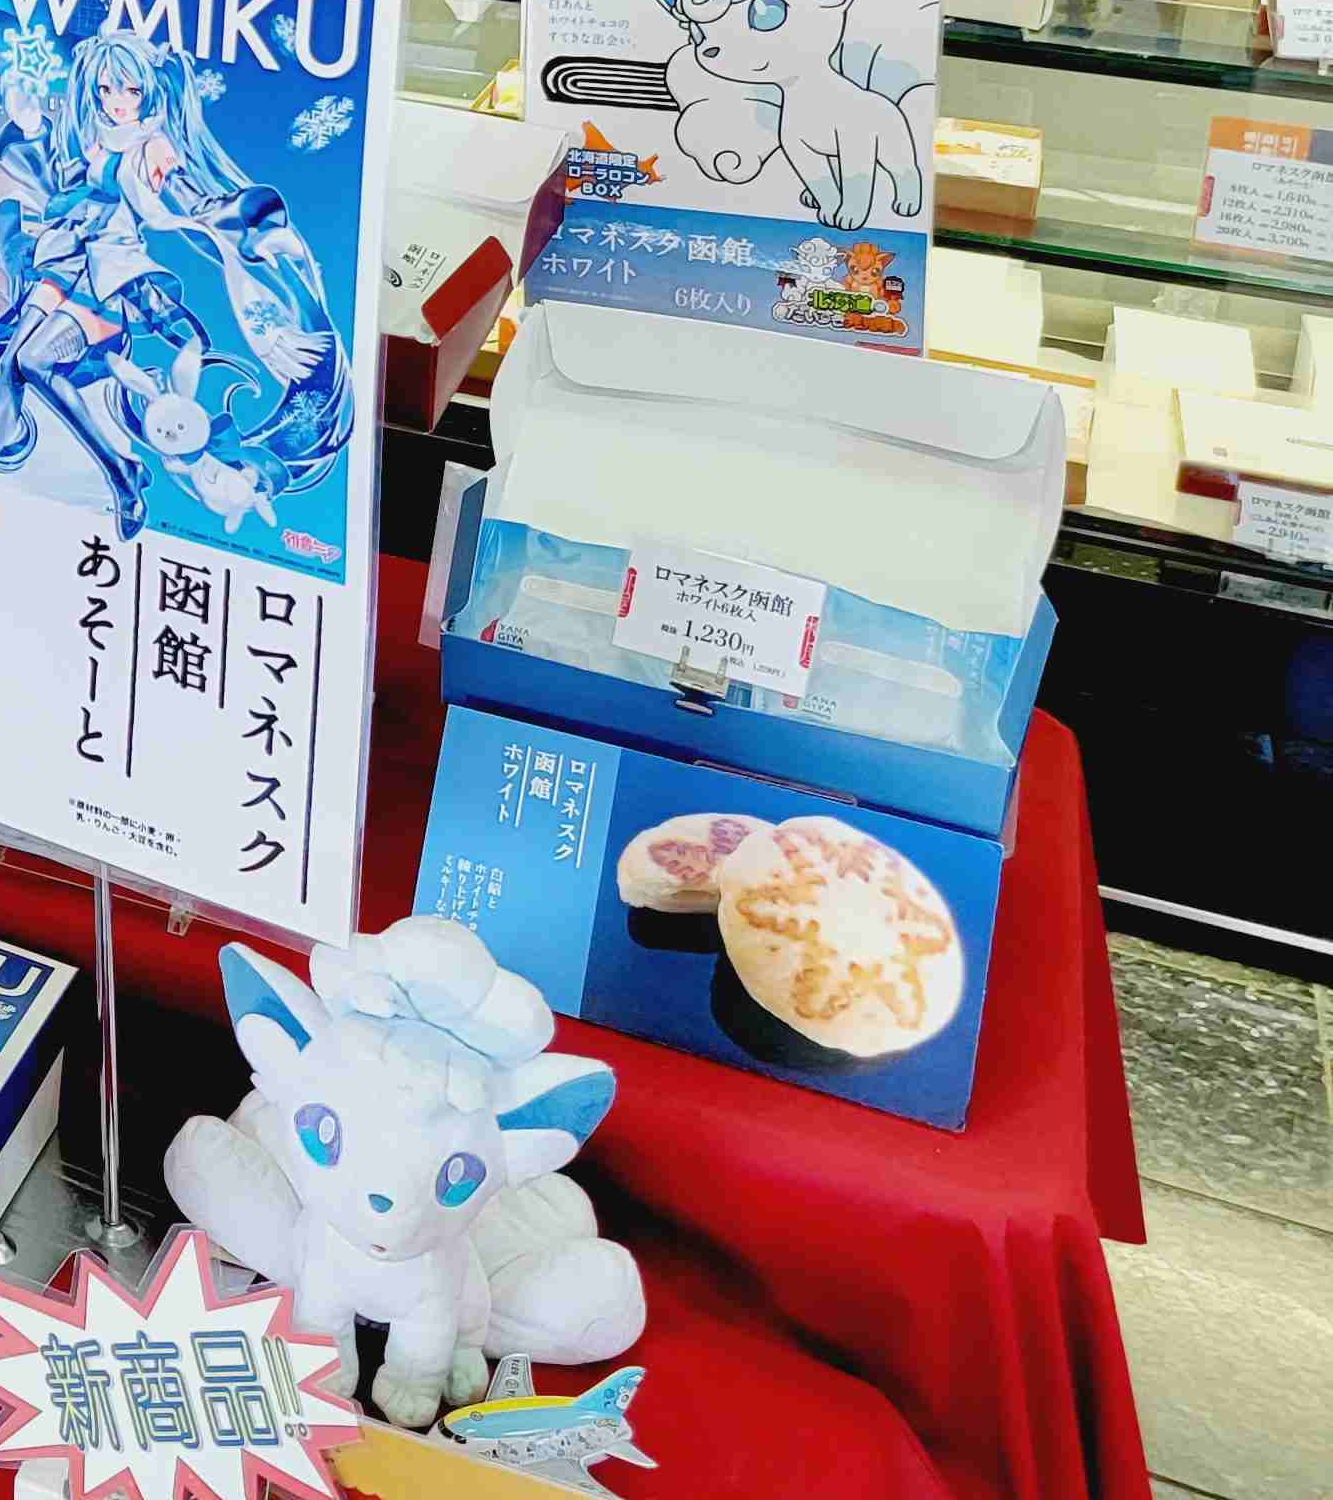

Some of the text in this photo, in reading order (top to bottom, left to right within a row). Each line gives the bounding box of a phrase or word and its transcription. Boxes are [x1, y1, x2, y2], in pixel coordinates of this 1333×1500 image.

[582, 183, 622, 198] BOX
[543, 252, 637, 285] ホワイト
[674, 286, 752, 316] 6枚入り
[654, 565, 794, 618] ロマネスク函館
[676, 591, 757, 623] ホワイト6枚入
[74, 534, 123, 764] あそーと
[153, 556, 212, 694] 函館
[683, 619, 755, 657] 1,230円
[238, 584, 299, 874] ロマネスク
[498, 743, 524, 823] ホワイト
[528, 750, 558, 800] 函館
[553, 759, 586, 861] ロマネスク
[433, 854, 453, 921] ミルキーな
[39, 1329, 309, 1454] 新商品!!
